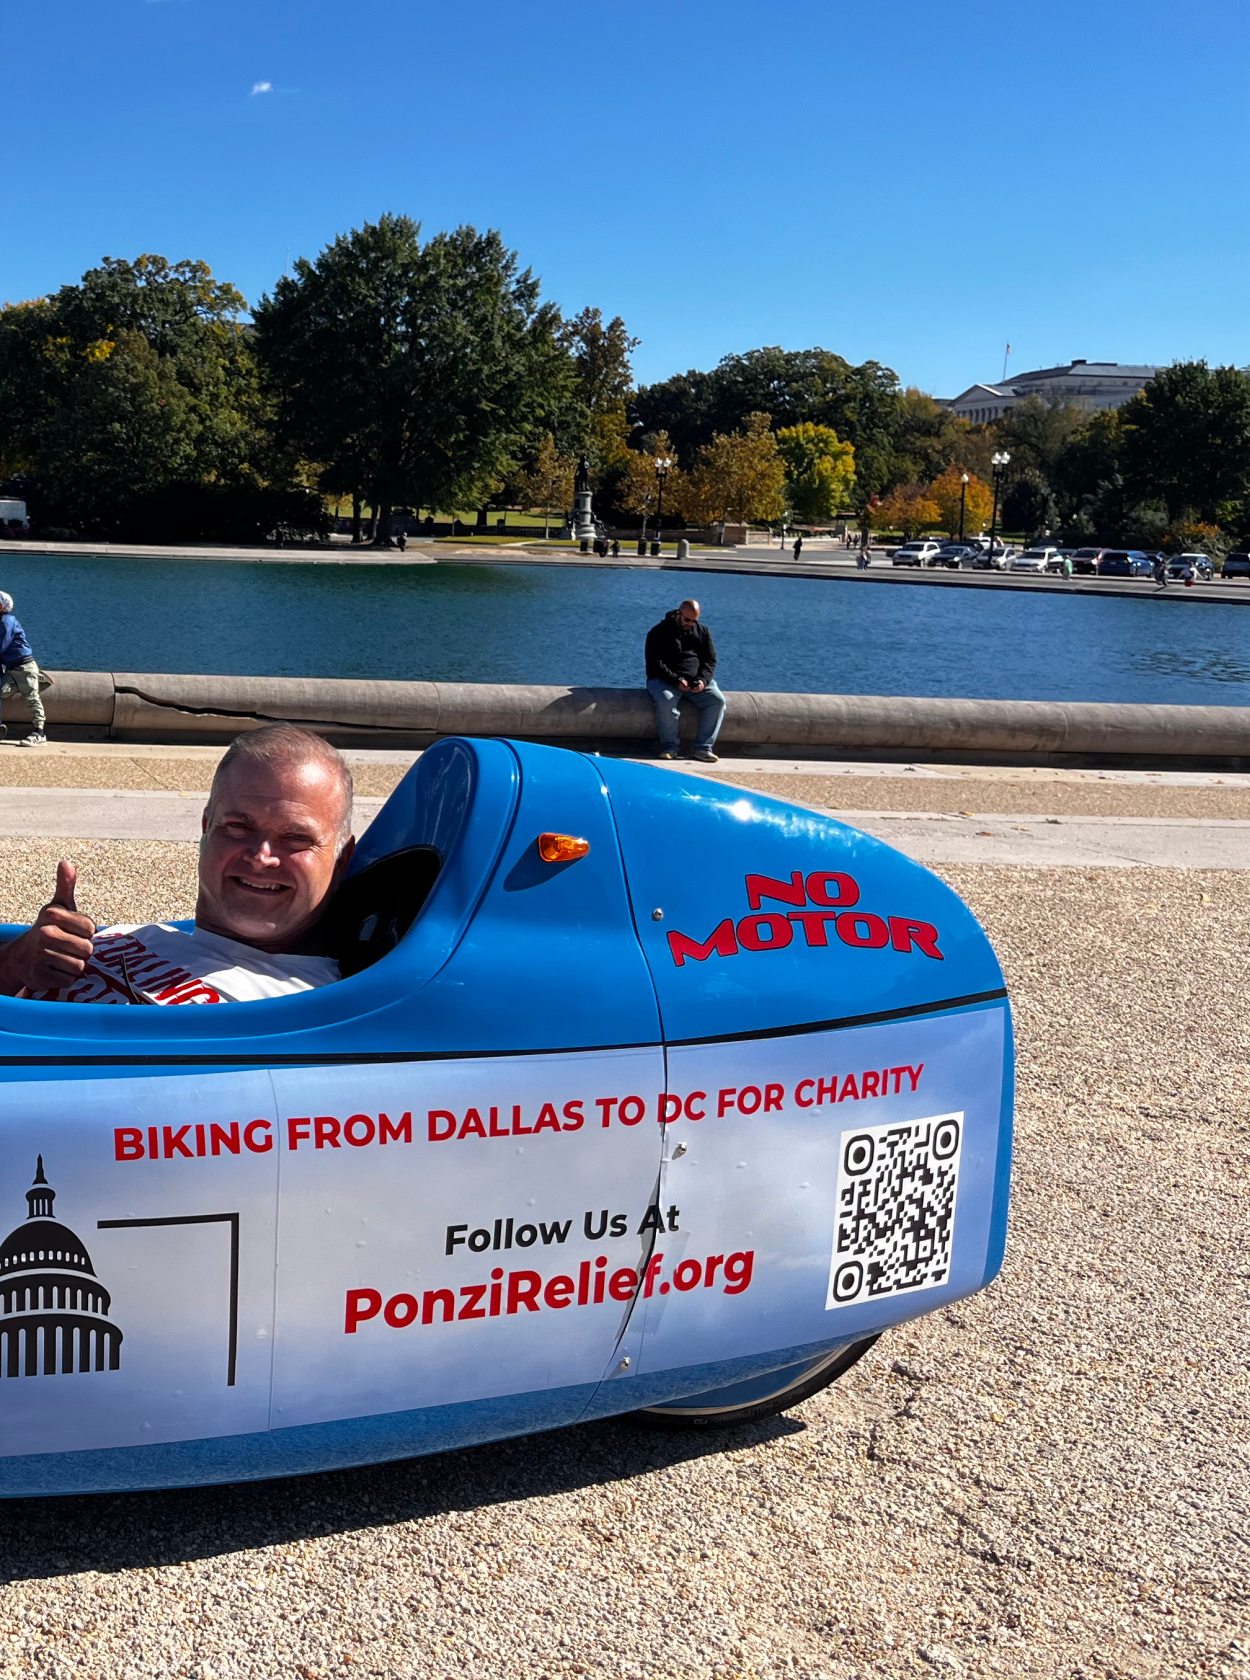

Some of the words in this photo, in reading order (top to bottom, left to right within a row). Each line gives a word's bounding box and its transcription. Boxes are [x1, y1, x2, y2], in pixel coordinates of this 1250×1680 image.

[745, 871, 860, 910] NO
[666, 911, 944, 967] MOTOR
[113, 1119, 274, 1161] BIKING
[287, 1112, 412, 1151] FROM
[427, 1099, 584, 1142] DALLAS
[596, 1095, 645, 1128] TO
[657, 1090, 707, 1124] DC
[717, 1083, 784, 1118] FOR
[793, 1063, 925, 1108] CHARITY
[444, 1217, 572, 1256] Follow
[583, 1209, 628, 1241] Us
[637, 1204, 680, 1236] At
[344, 1249, 755, 1334] PonziRelief.org
